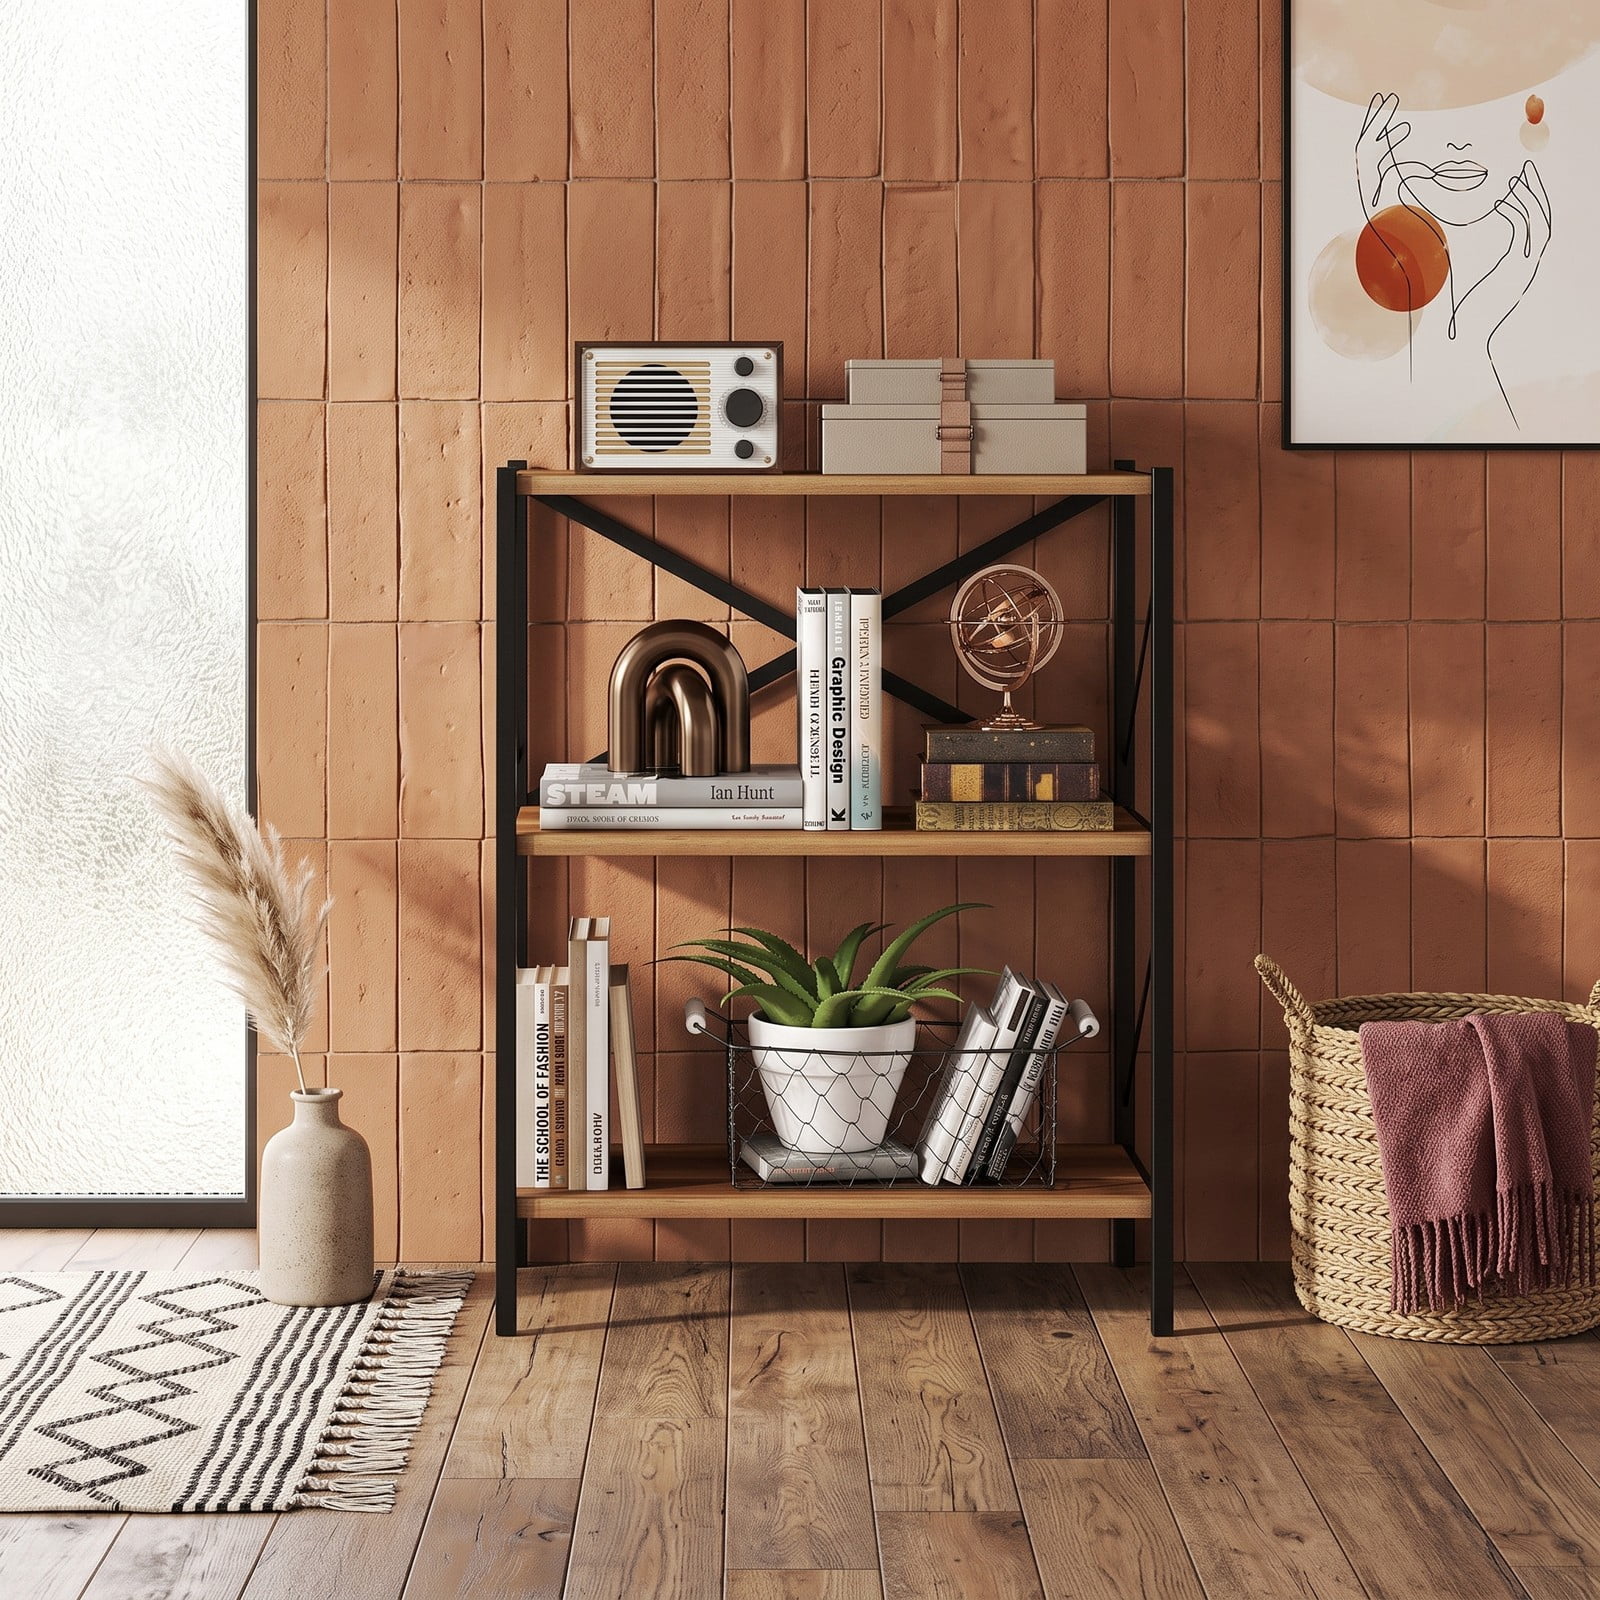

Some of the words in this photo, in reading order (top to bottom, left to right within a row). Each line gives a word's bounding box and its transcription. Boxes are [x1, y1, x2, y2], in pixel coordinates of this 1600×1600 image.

[829, 657, 846, 722] Graphic
[830, 727, 846, 784] Design
[546, 783, 657, 805] STEAM
[711, 785, 733, 800] Ian
[737, 785, 775, 800] Hunt
[831, 808, 846, 821] K
[536, 1023, 549, 1079] FASHION
[536, 1083, 549, 1099] OF
[536, 1103, 549, 1154] SCHOOL
[536, 1158, 549, 1182] THE
